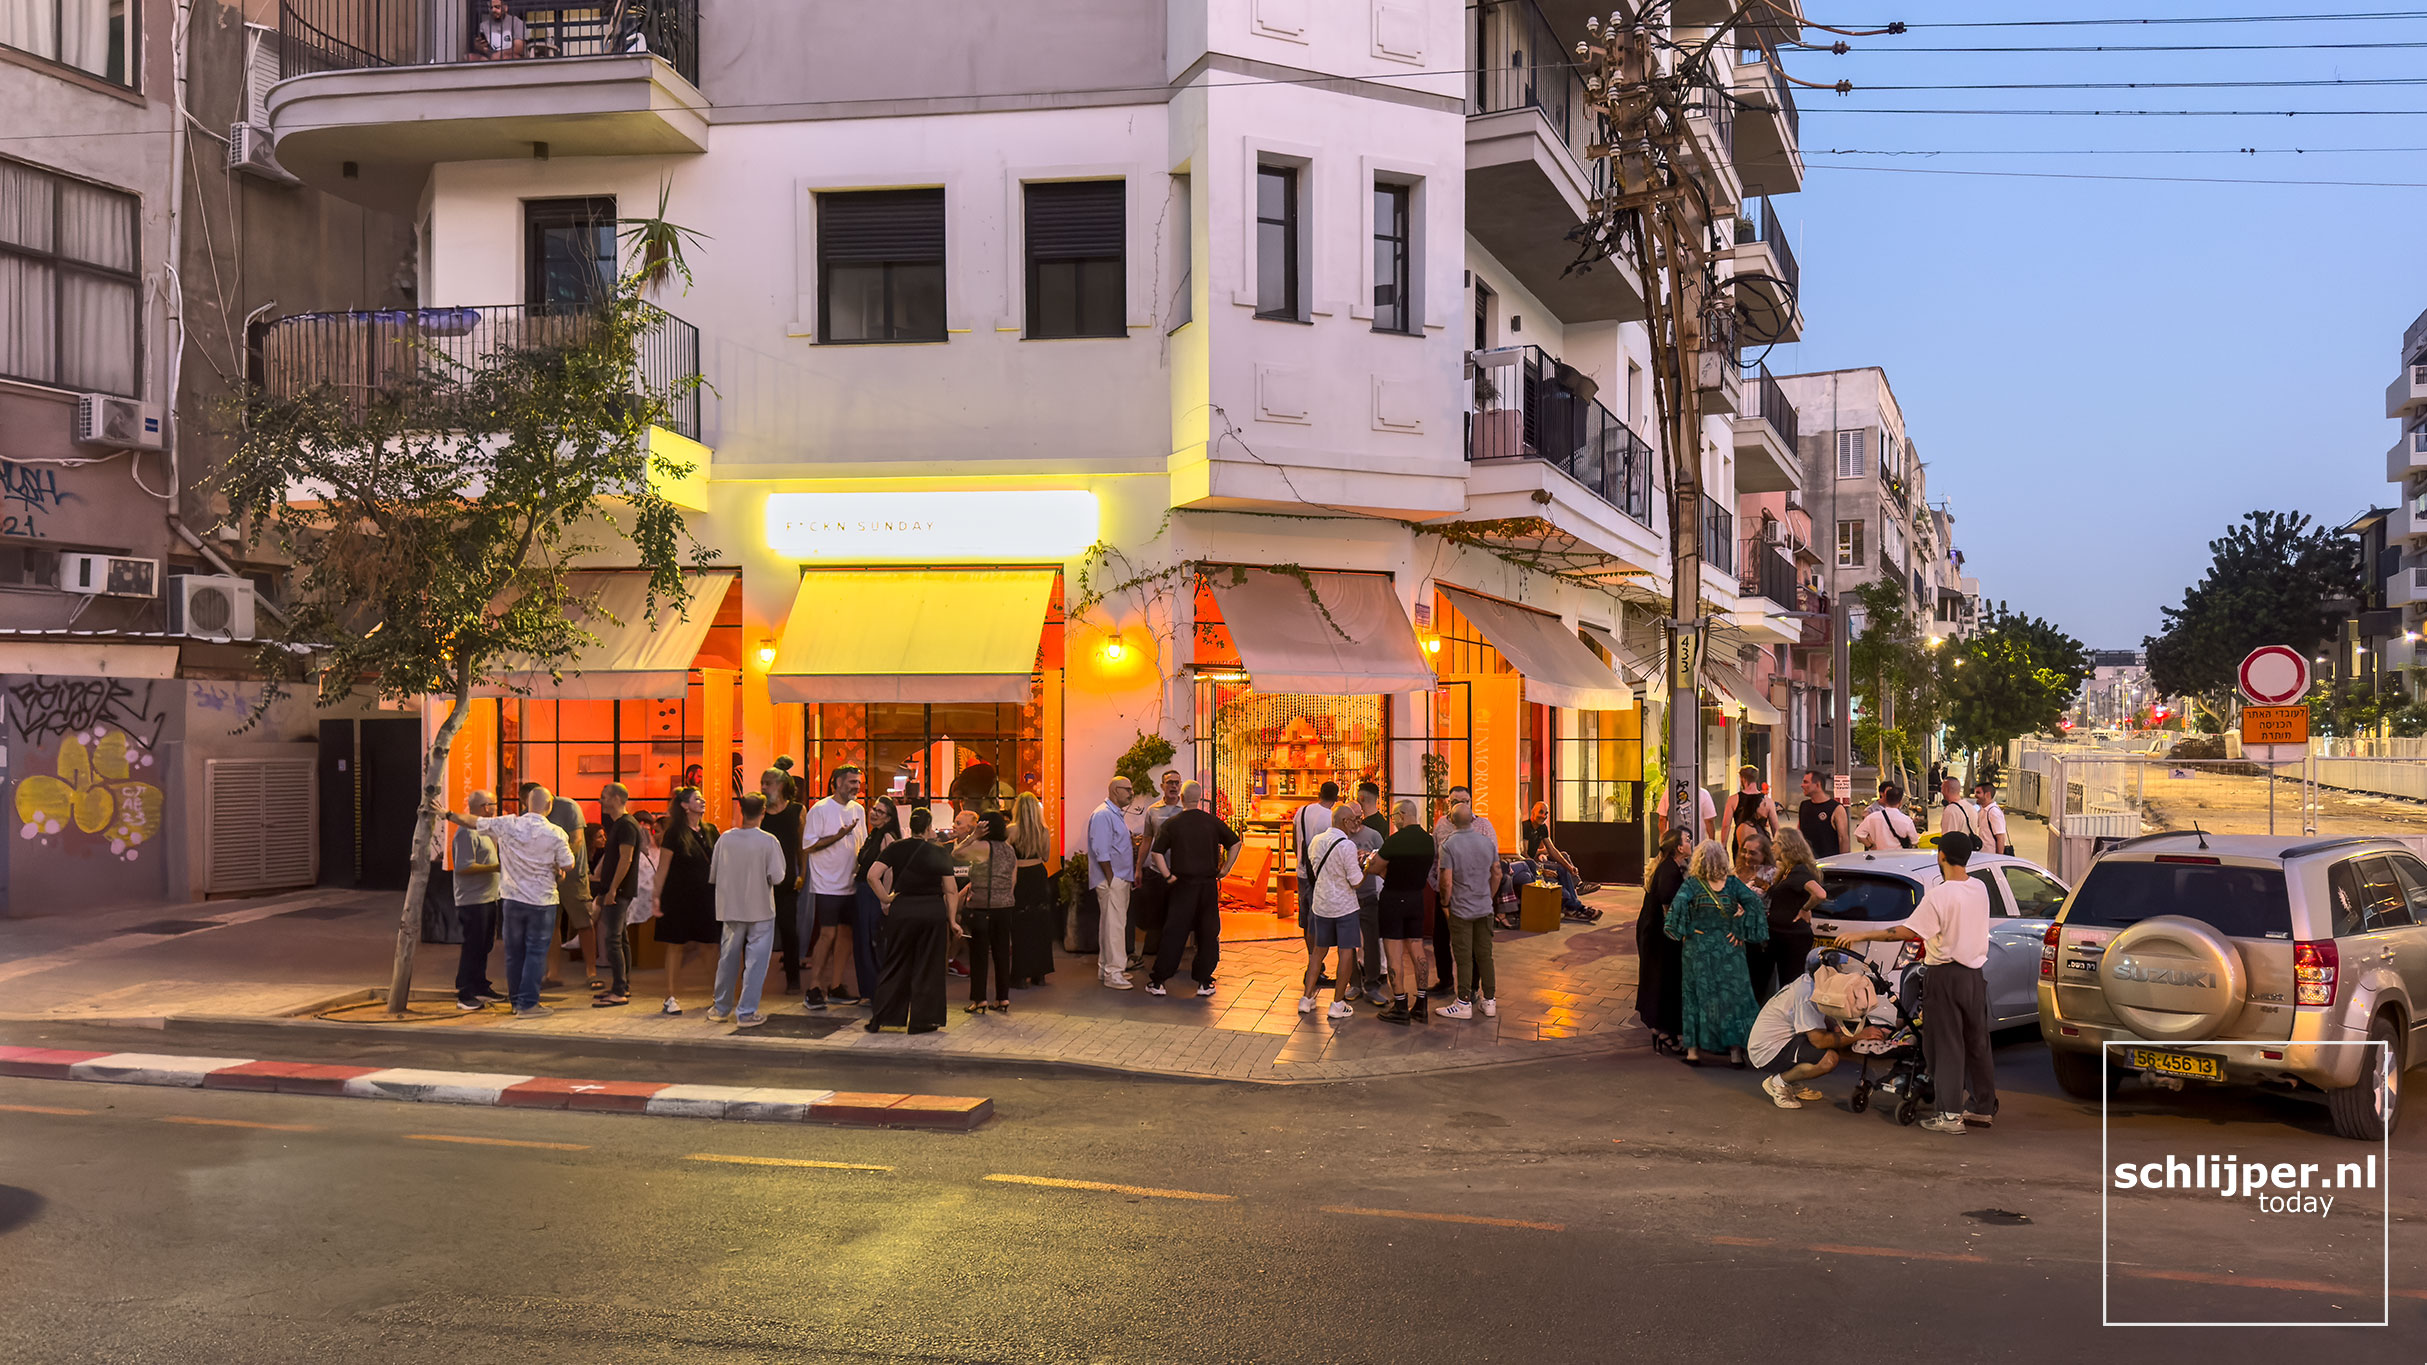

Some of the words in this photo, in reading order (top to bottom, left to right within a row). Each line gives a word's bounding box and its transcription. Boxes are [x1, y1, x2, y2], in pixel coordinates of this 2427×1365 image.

[857, 521, 935, 532] SUNDAY
[2246, 710, 2271, 719] האתר
[2275, 709, 2305, 718] לעובדי
[2259, 721, 2293, 729] הכניסה
[2261, 732, 2292, 740] מותרת
[2112, 965, 2216, 988] SUZUKI
